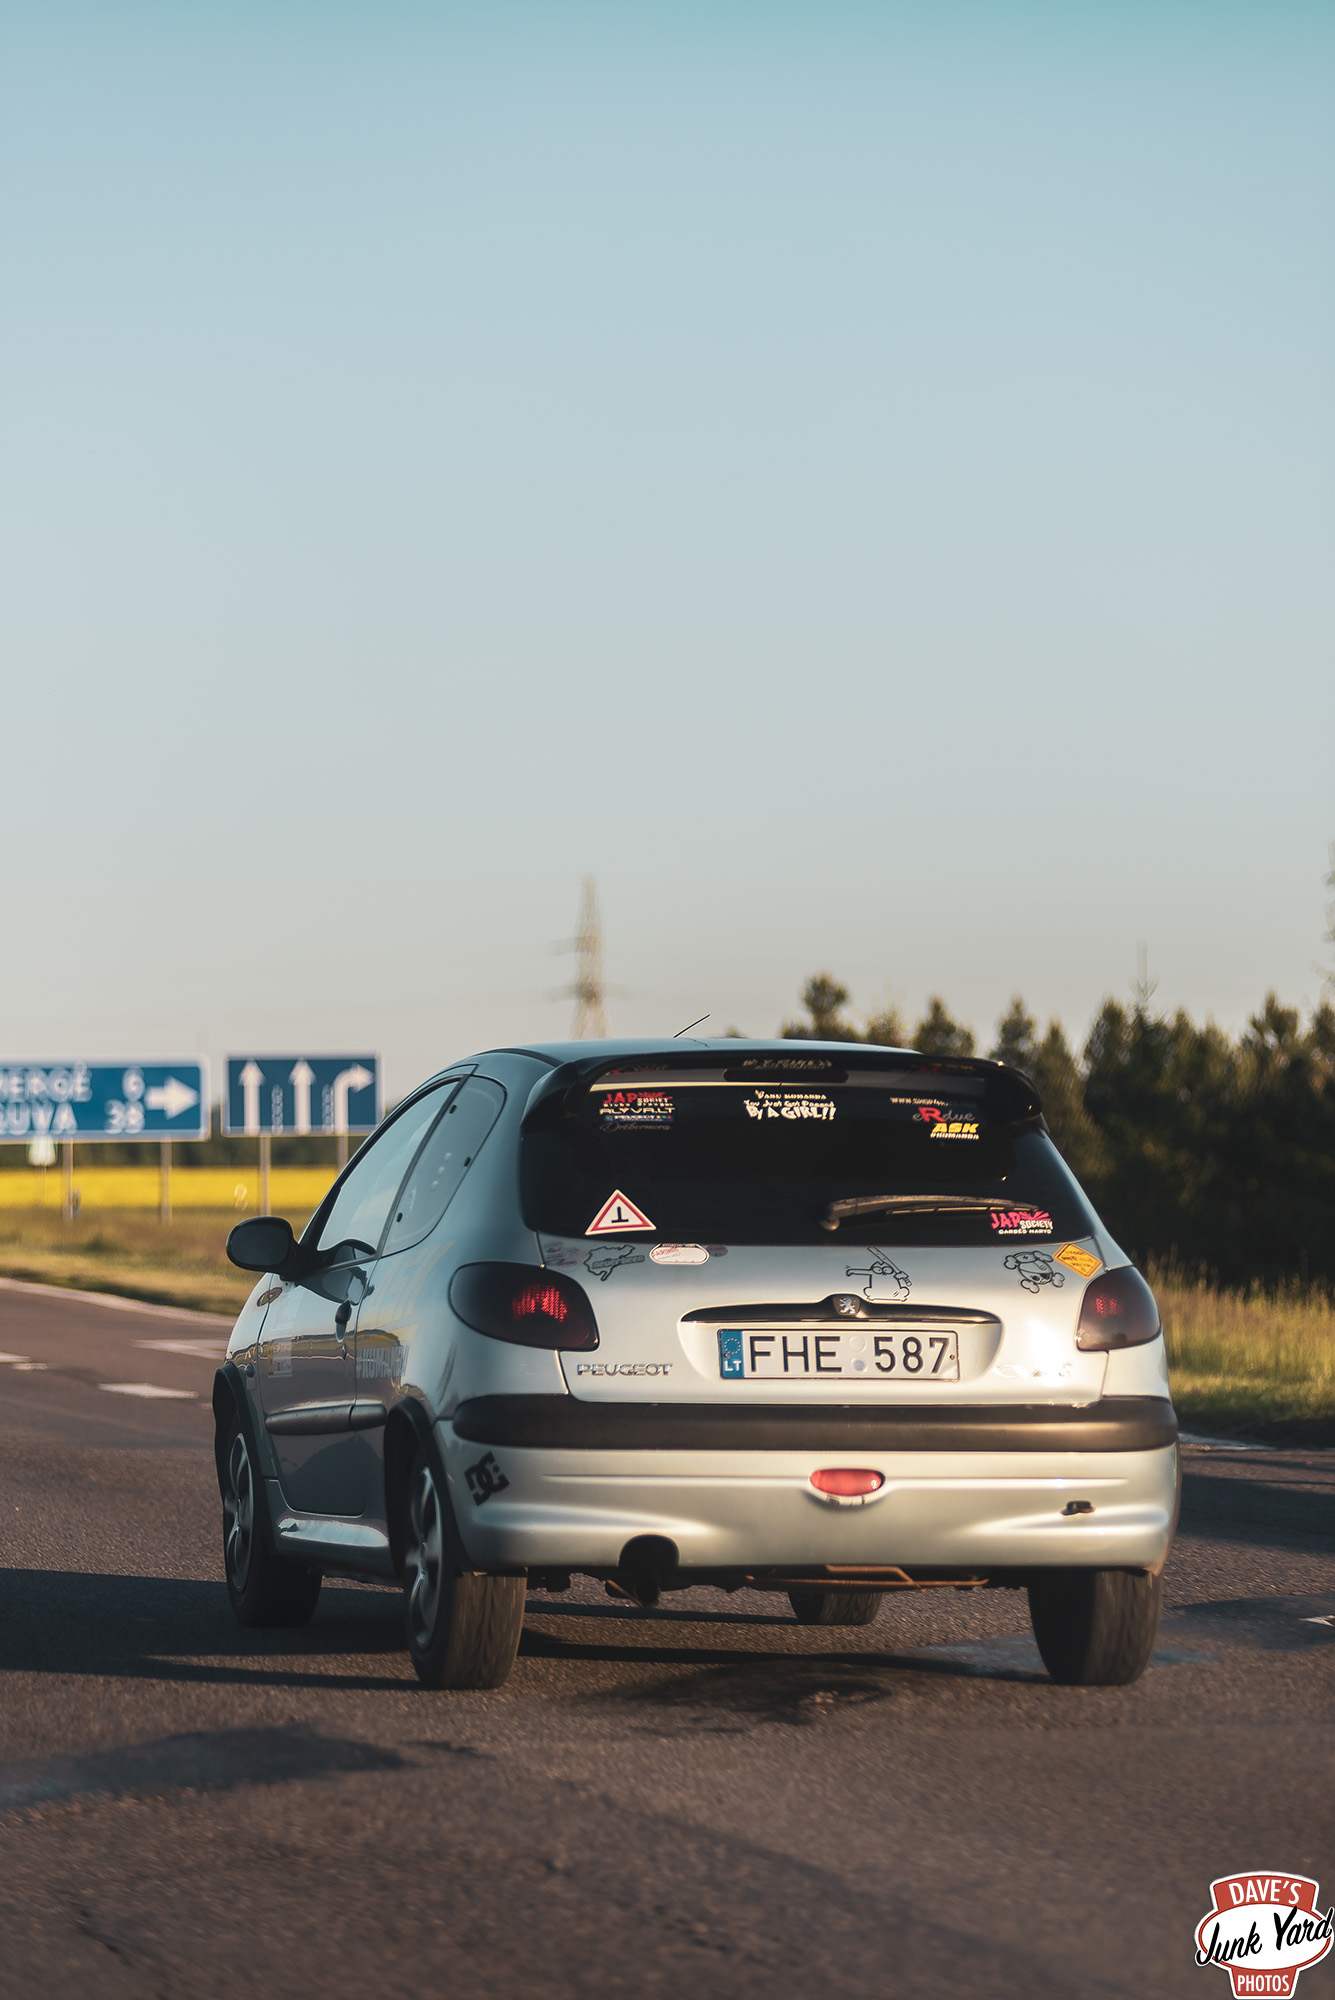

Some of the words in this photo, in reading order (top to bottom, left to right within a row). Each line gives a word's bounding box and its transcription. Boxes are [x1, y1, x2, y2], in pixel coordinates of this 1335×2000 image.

[767, 1107, 780, 1118] A
[781, 1106, 837, 1120] GIRL!!
[931, 1122, 979, 1133] ASK
[990, 1211, 1021, 1230] JAP
[1019, 1220, 1053, 1230] SOCIETY
[749, 1335, 842, 1373] FHE
[873, 1336, 950, 1374] 587
[576, 1363, 673, 1377] PEUGEOT
[724, 1360, 742, 1372] LT
